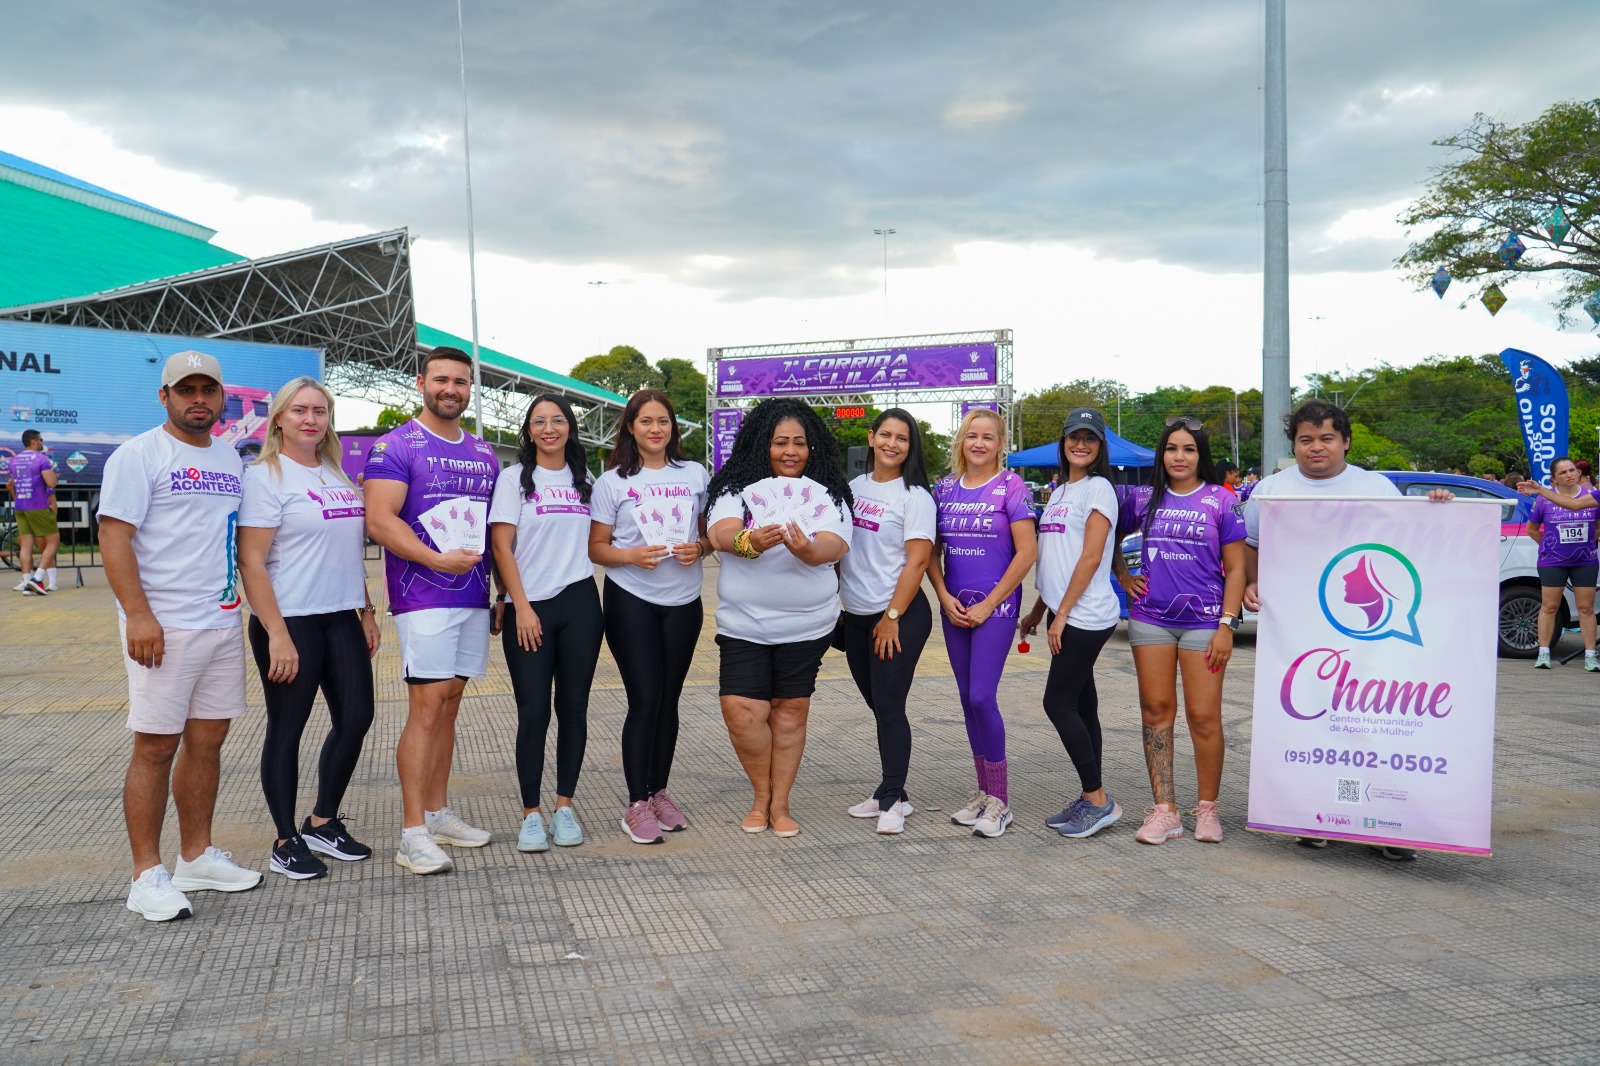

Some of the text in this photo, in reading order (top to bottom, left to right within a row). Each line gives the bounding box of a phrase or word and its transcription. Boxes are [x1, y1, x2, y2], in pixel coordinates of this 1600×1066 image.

[803, 354, 909, 371] CORRIDA
[778, 366, 909, 387] Agosto LILÁS
[960, 372, 988, 381] SHAMAR
[35, 409, 78, 417] GOVERNO
[1533, 432, 1543, 463] DOS
[440, 458, 493, 476] CORRIDA
[644, 486, 692, 499] Mulher
[942, 502, 996, 516] CORRIDA
[1154, 508, 1207, 524] CORRIDA
[951, 514, 993, 532] LILÁS
[1164, 521, 1206, 540] LILÁS
[1566, 528, 1583, 538] 194
[948, 546, 985, 557] Teltronic
[1280, 647, 1453, 721] Chame
[1330, 714, 1424, 728] Centro Humanitário
[1330, 724, 1341, 732] de
[1343, 725, 1370, 734] Apoio
[1380, 727, 1415, 737] Mulher
[1377, 819, 1402, 827] Roraima
